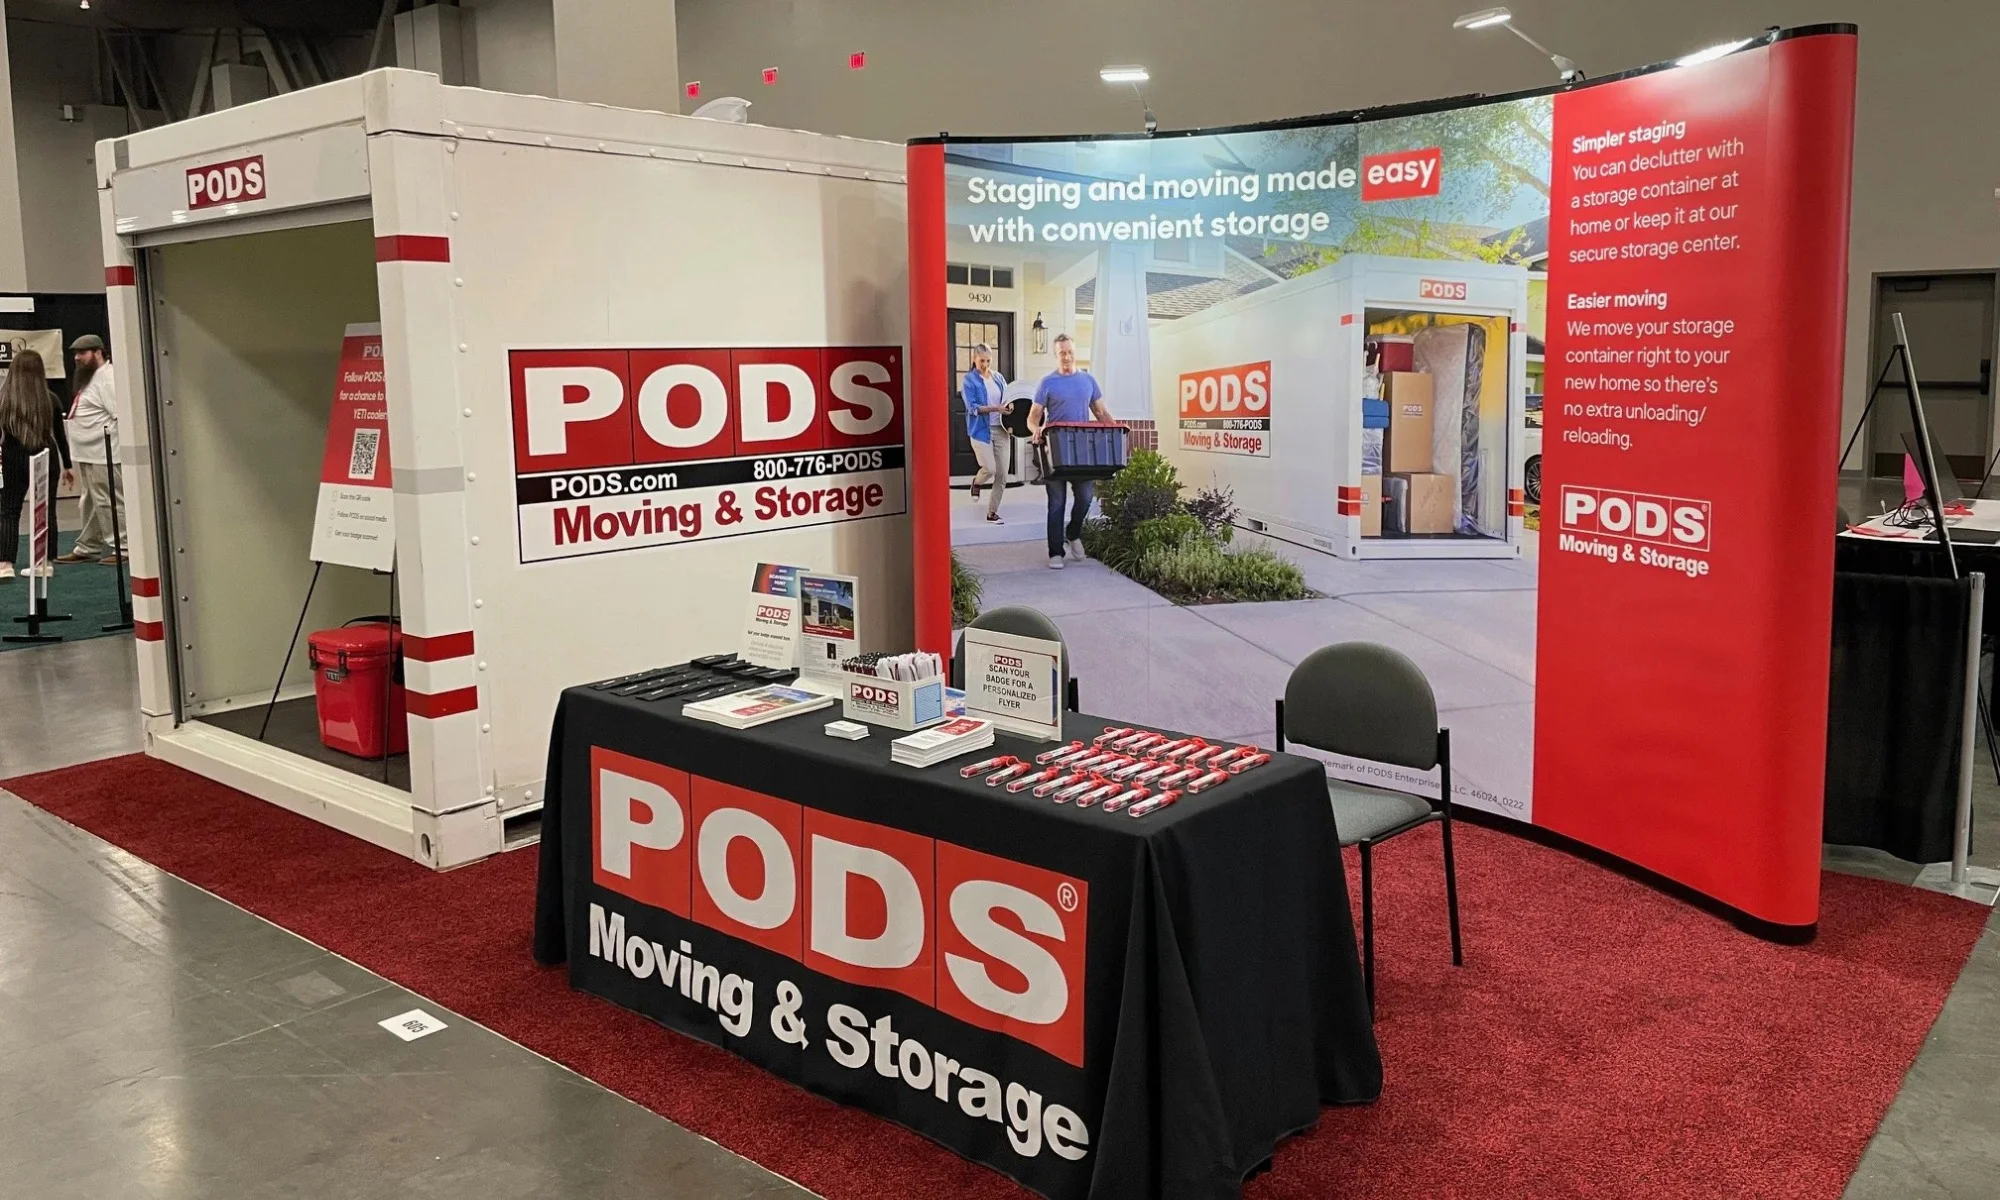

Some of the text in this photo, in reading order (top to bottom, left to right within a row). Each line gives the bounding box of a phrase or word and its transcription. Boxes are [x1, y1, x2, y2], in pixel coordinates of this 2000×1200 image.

[1572, 120, 1686, 154] Simpler staging
[1572, 137, 1744, 180] You can declutter with
[188, 161, 263, 205] PODS
[967, 158, 1437, 210] Staging and moving made easy
[1571, 170, 1739, 208] a storage container at
[968, 211, 1330, 242] with convenient storage
[1570, 204, 1738, 236] home or keep it at our
[1569, 234, 1740, 263] secure storage center.
[968, 293, 991, 303] 9430
[1421, 282, 1465, 298] PODS
[1567, 289, 1667, 310] Easier moving
[1567, 319, 1734, 339] We move your storage
[1565, 346, 1730, 368] container right to your
[364, 371, 382, 382] PODS
[1564, 373, 1718, 394] new home so there's
[340, 390, 349, 400] for
[354, 390, 376, 400] chance
[377, 391, 384, 400] to
[1181, 370, 1267, 412] PODS
[1183, 420, 1207, 429] PODS.com
[1564, 403, 1707, 427] no extra unloading/
[1184, 431, 1262, 454] Moving & Storage
[1563, 427, 1633, 450] reloading.
[551, 451, 883, 499] PODS.com 800-776-PODS
[553, 483, 884, 545] Moving & Storage
[1559, 534, 1709, 577] Moving & Storage
[758, 607, 790, 619] PODS
[989, 664, 1030, 678] SCAN YOUR
[995, 655, 1022, 667] PODS
[986, 674, 1010, 685] BADGE
[1012, 680, 1026, 688] FOR
[852, 685, 898, 704] PODS
[983, 684, 1037, 701] PERSONALIZED
[999, 698, 1020, 709] FLYER
[1357, 765, 1365, 773] of
[1367, 767, 1392, 779] PODS
[402, 1020, 428, 1033] 605
[589, 902, 1089, 1161] Moving & Storage
